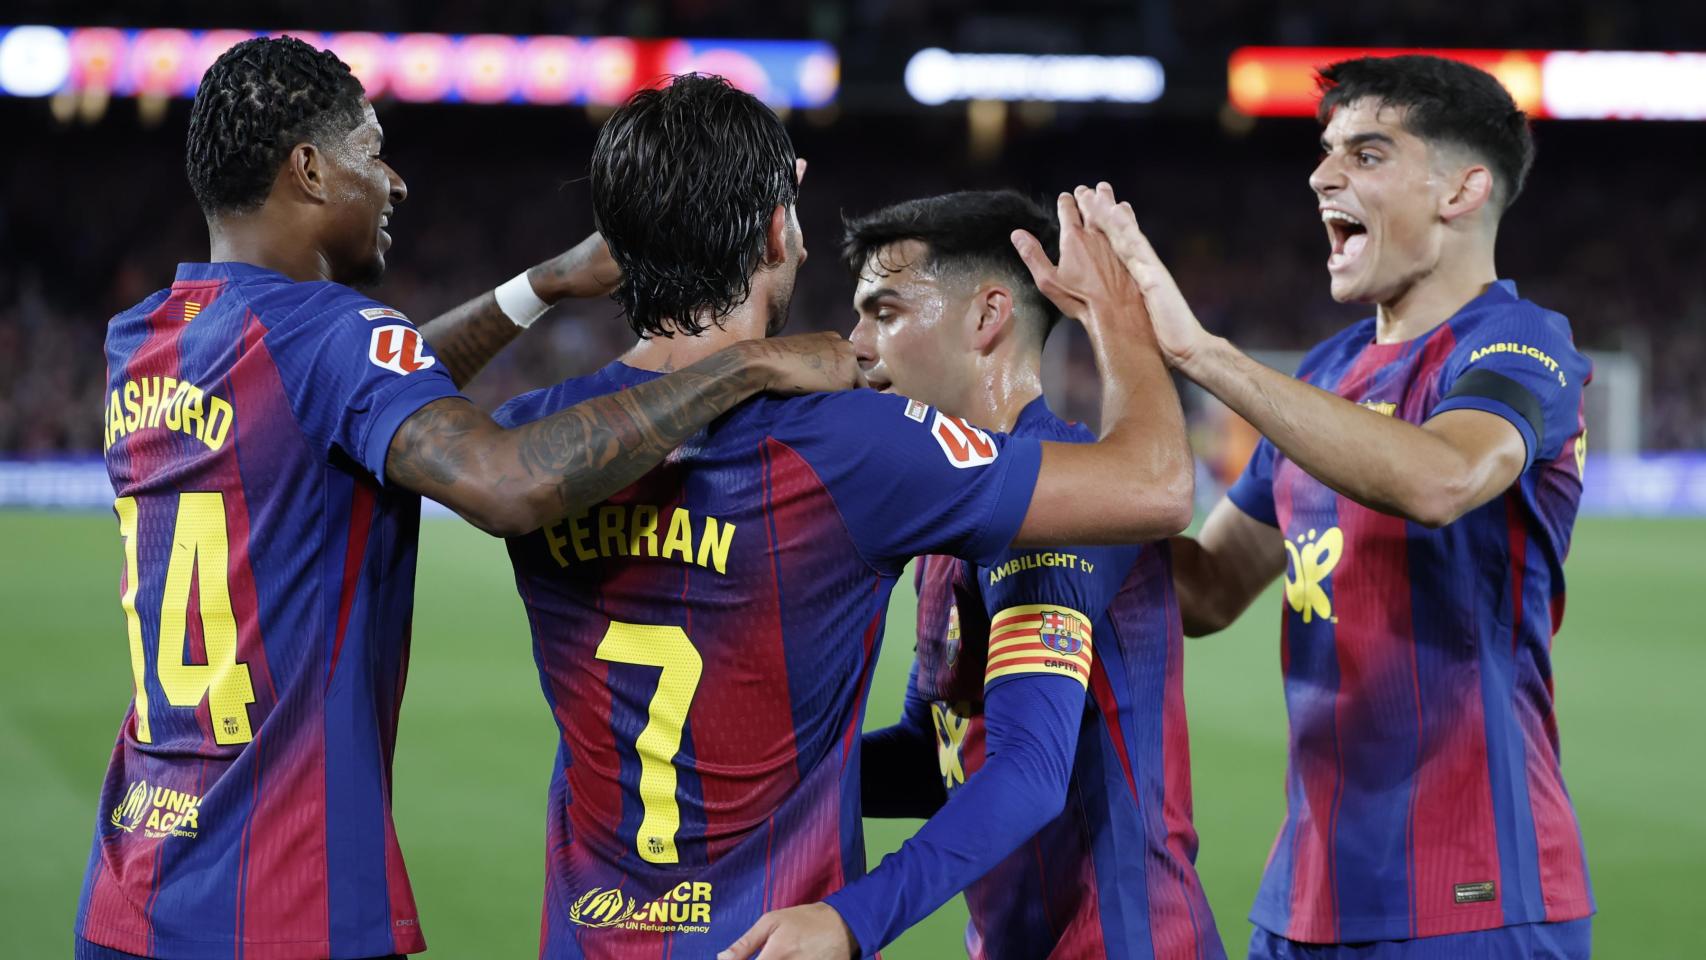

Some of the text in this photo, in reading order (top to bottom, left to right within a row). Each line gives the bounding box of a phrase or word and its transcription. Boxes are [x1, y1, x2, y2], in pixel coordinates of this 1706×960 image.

[1470, 343, 1559, 372] AMBILIGHT
[543, 504, 736, 575] FERRAN
[990, 553, 1094, 586] AMBILIGHT tv
[114, 492, 255, 745] 14
[595, 620, 703, 864] 7
[153, 786, 202, 814] UNH
[146, 807, 199, 832] ACR
[625, 922, 638, 930] UN
[640, 923, 676, 933] Refugee
[677, 923, 710, 934] Agency
